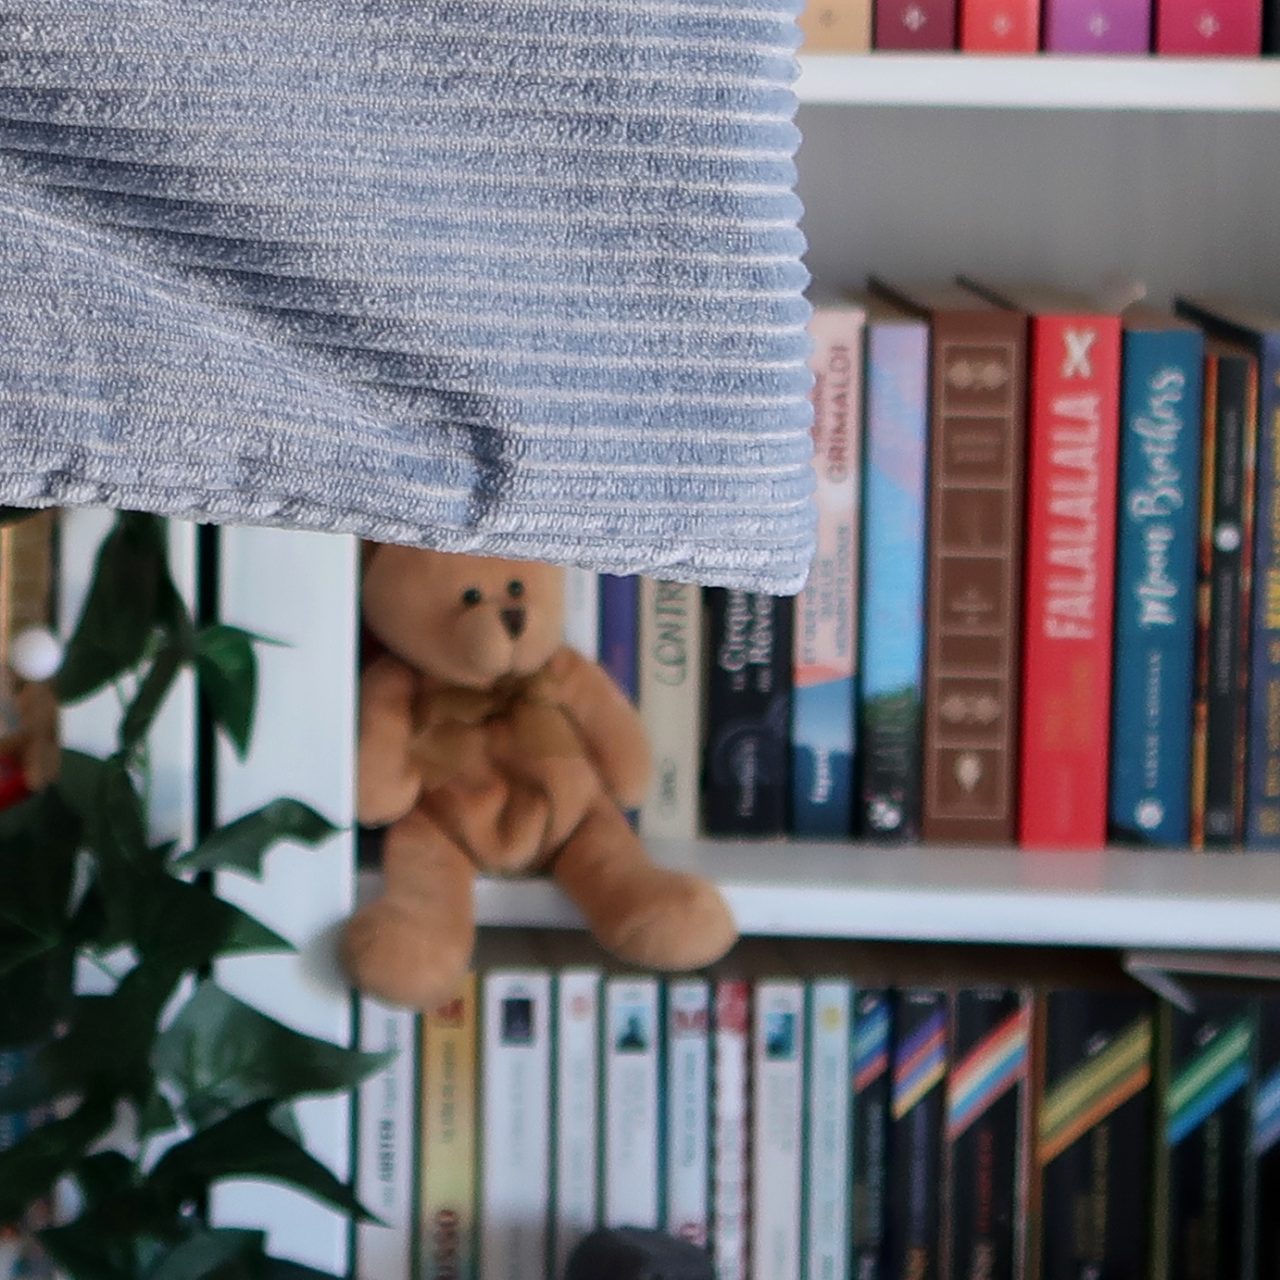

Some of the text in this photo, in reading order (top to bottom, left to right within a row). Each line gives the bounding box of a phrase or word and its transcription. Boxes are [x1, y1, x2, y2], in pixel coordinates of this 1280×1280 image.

[825, 344, 851, 483] GRIMALDI
[652, 577, 688, 686] CONTR
[718, 590, 753, 671] Cirqu
[748, 594, 773, 664] Rêve
